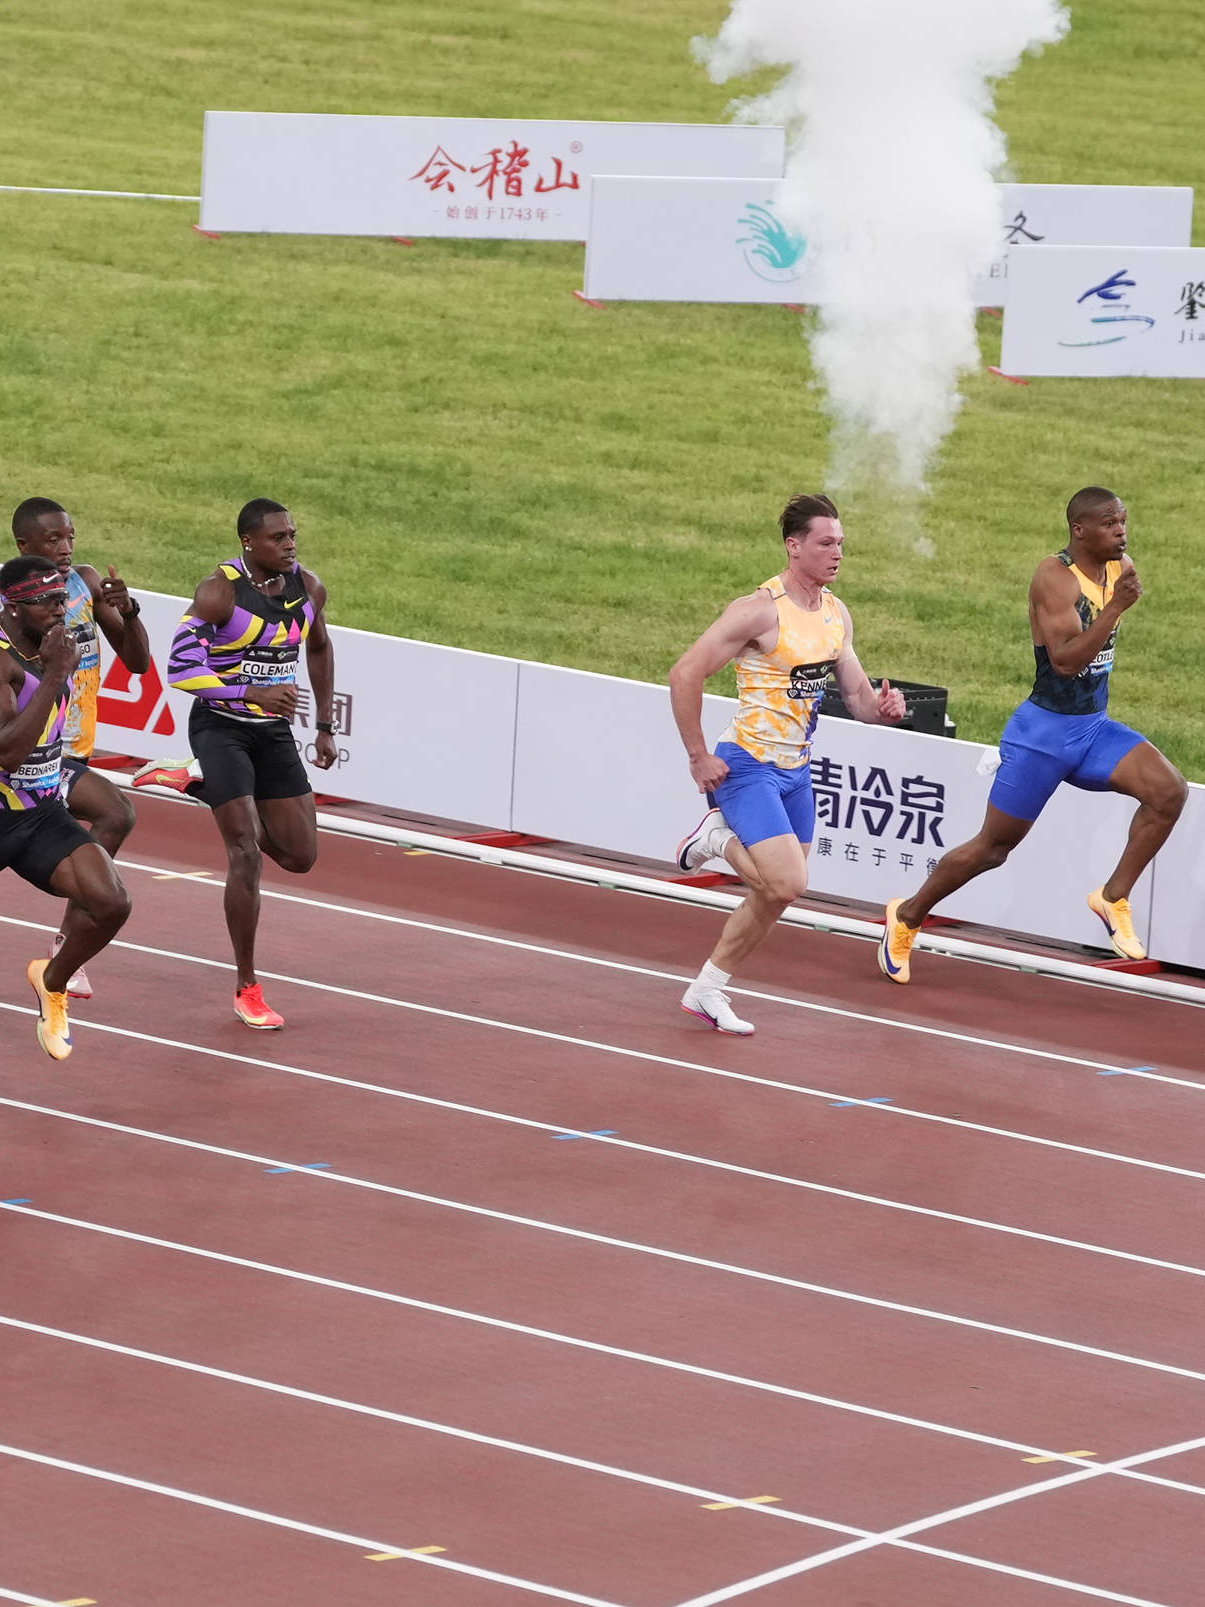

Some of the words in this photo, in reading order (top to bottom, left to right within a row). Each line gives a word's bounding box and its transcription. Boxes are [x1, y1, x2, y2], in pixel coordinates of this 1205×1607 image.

[408, 140, 580, 200] 会稽山
[242, 663, 296, 676] COLEMAN
[18, 761, 58, 776] BEDNAREK
